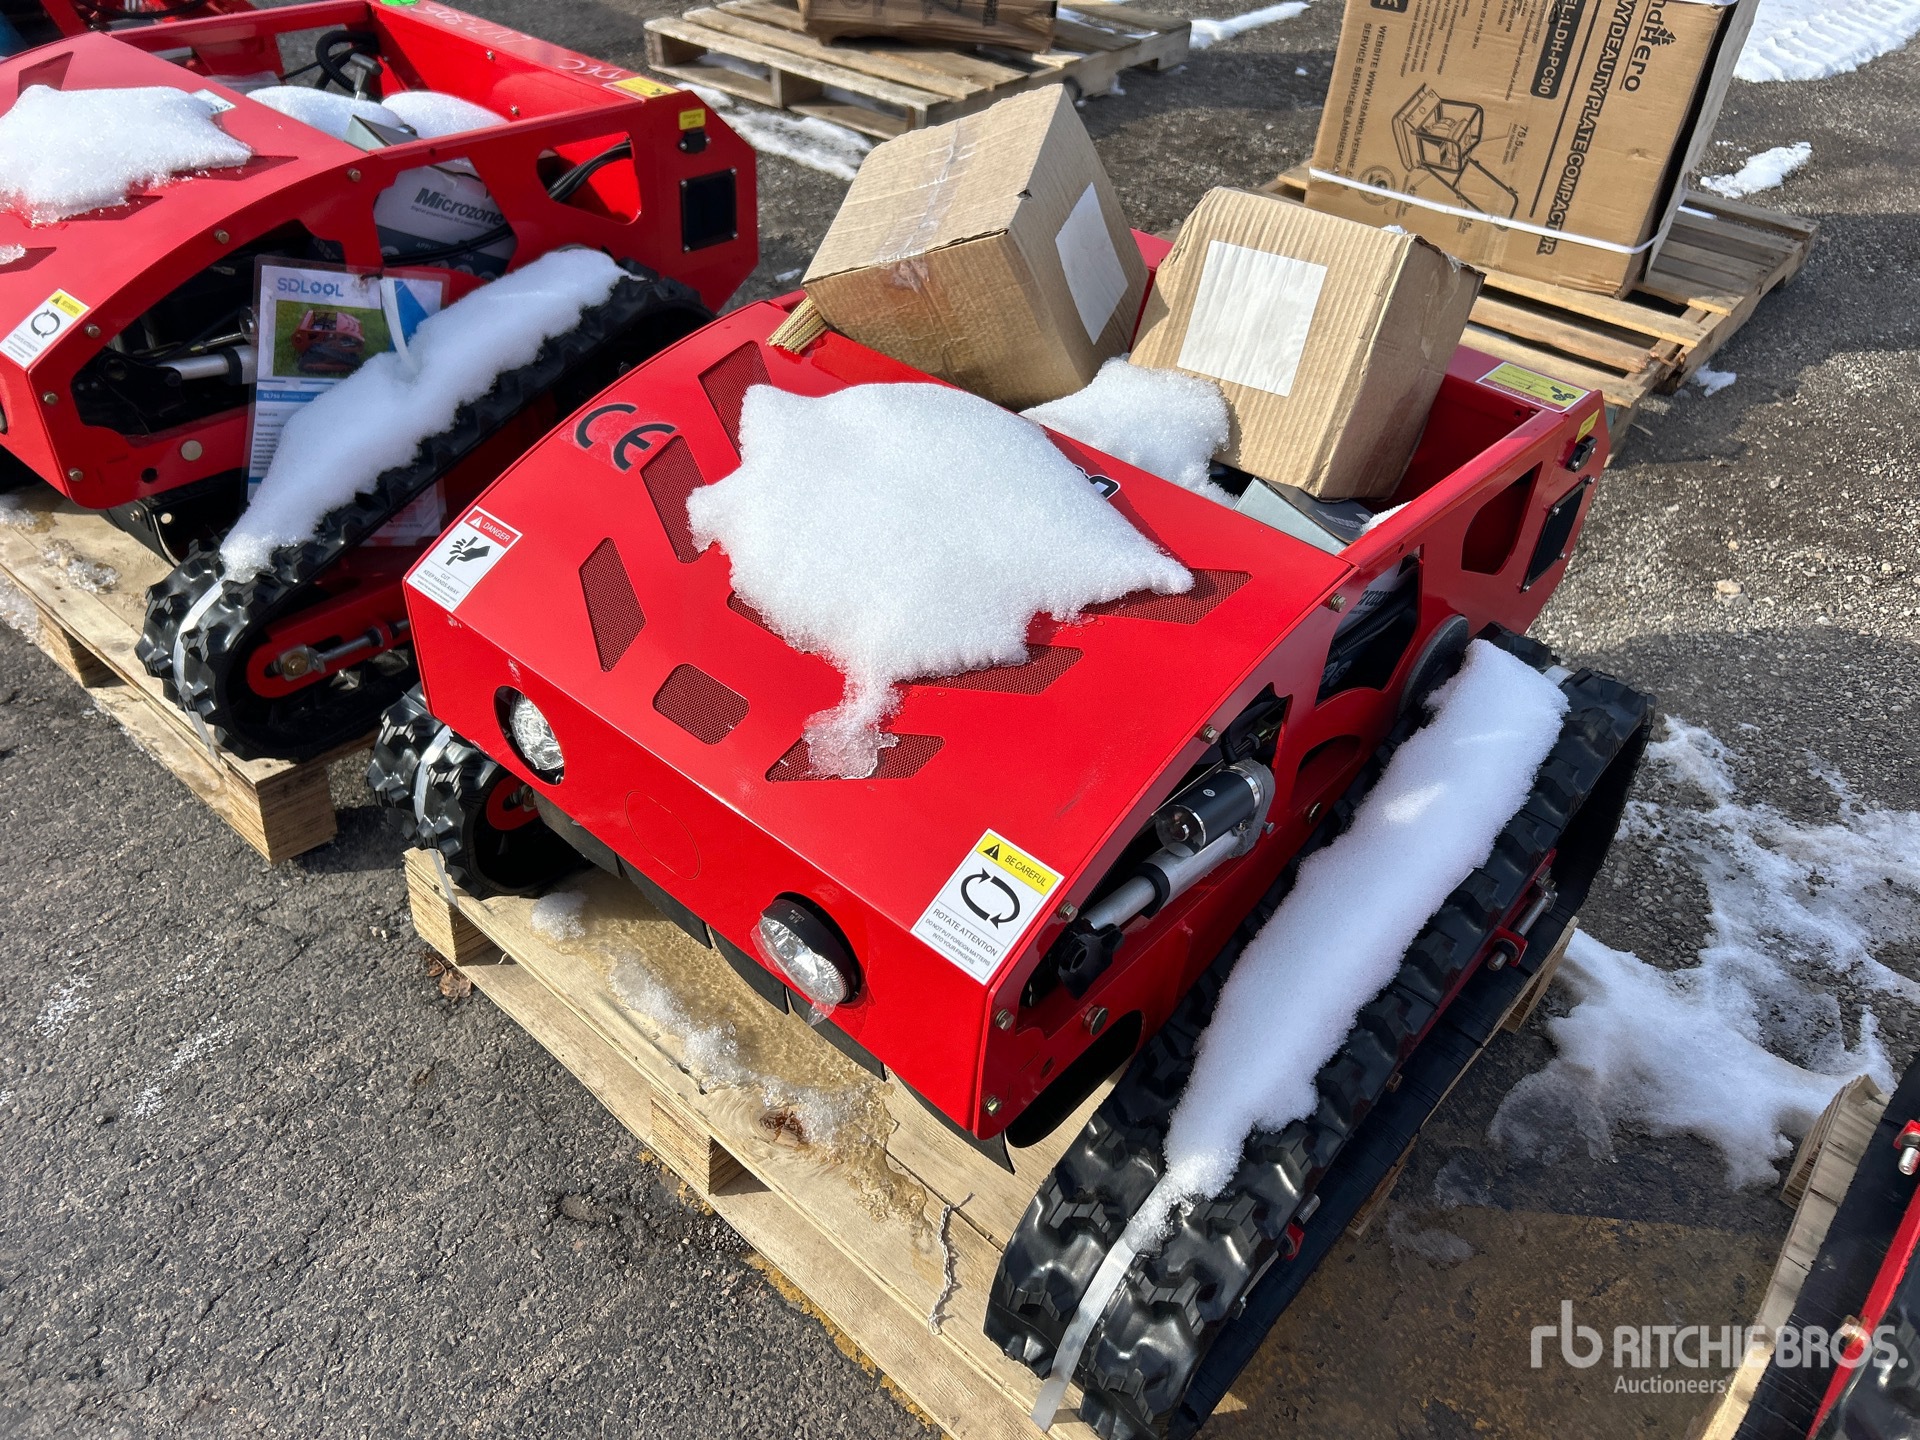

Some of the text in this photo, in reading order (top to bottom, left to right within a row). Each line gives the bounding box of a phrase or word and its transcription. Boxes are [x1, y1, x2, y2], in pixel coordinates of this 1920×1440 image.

[1355, 22, 1373, 64] SERVICE
[1369, 25, 1388, 69] WEBSITE
[1588, 21, 1634, 97] DEAUTY
[1570, 96, 1605, 153] PLATE
[413, 187, 505, 227] Microzone
[1536, 152, 1586, 256] COMPACTR
[277, 276, 344, 298] SDLOOL
[482, 521, 511, 541] DANGER
[423, 569, 459, 595] KEEP HANDS AWAY
[1004, 854, 1047, 886] BE CAREFUL
[932, 908, 997, 956] ROTATE ATTENTION
[932, 923, 942, 932] NOT
[941, 929, 951, 938] PUT
[949, 935, 970, 951] FOREIGN
[969, 949, 990, 965] MATTERS
[932, 933, 975, 964] INTO YOUR FINGERS
